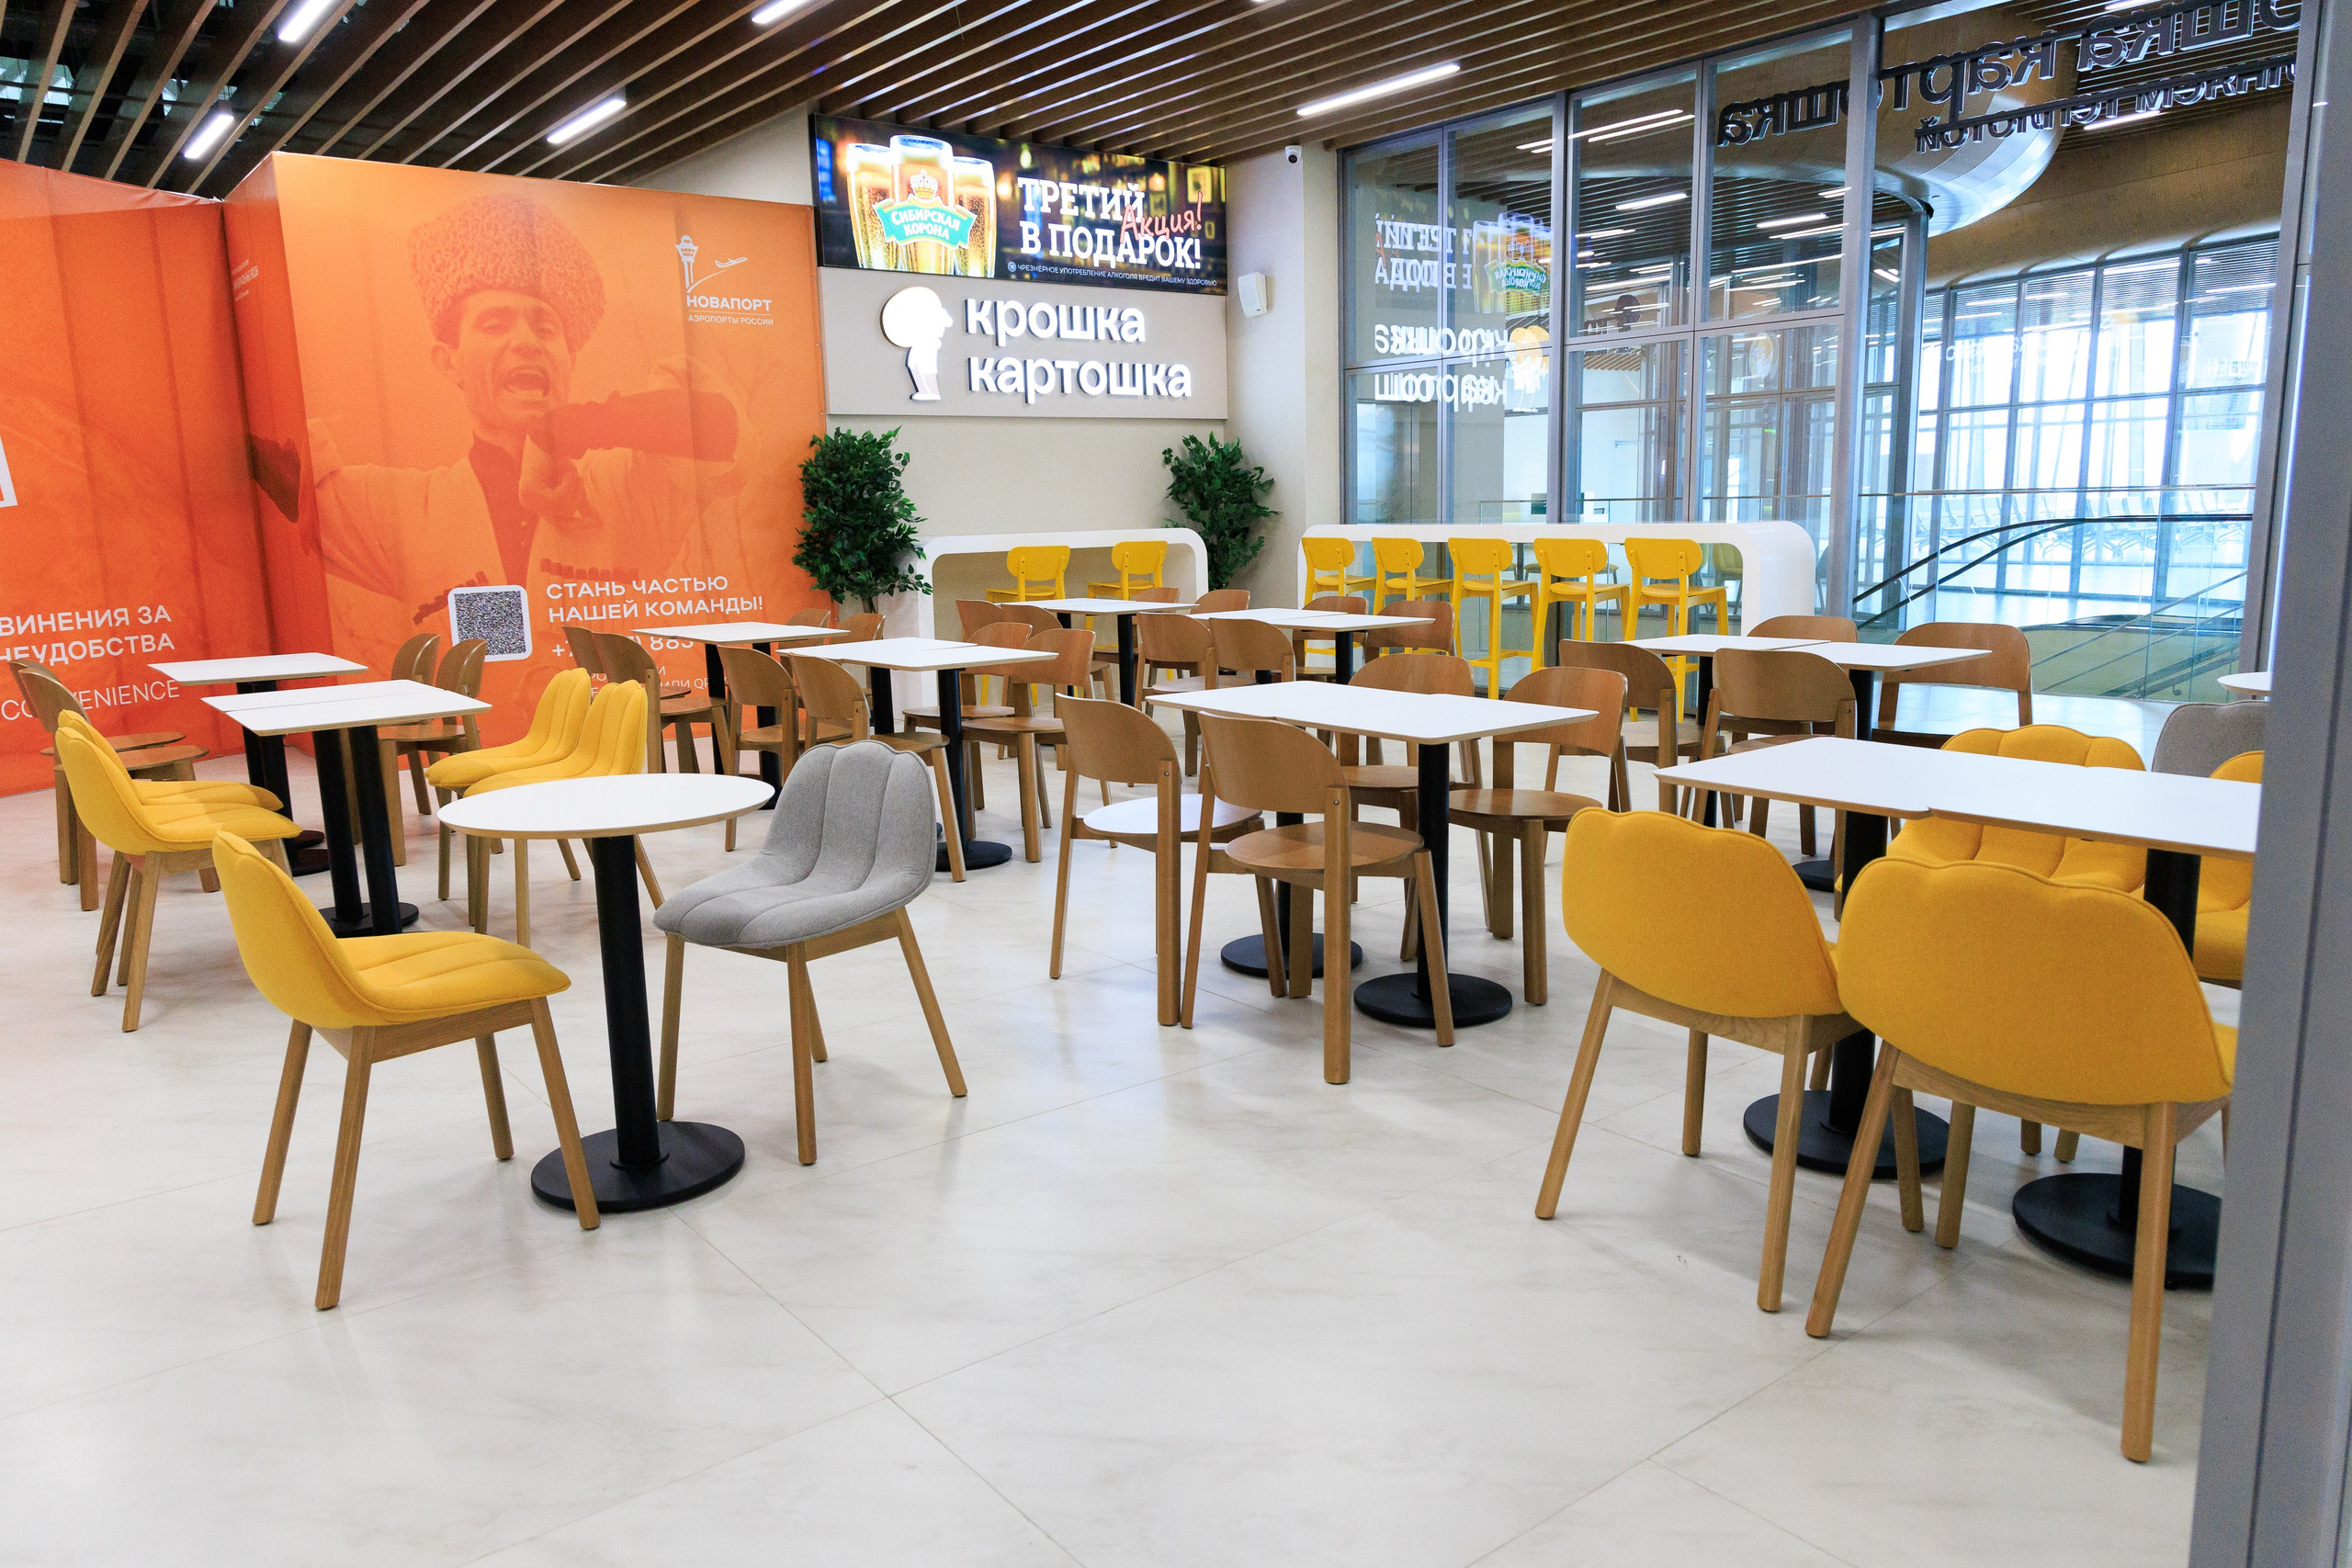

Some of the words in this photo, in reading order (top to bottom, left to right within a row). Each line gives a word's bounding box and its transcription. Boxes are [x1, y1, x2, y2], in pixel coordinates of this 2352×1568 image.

[1017, 176, 1146, 223] ТРЕТИЙ
[890, 209, 961, 231] СИБИРСКАЯ
[903, 222, 950, 240] КОРОНА
[1120, 190, 1204, 244] Акция!
[1020, 220, 1041, 254] В
[1048, 223, 1202, 269] ПОДАРОК!
[1017, 264, 1058, 274] ЧРЕЗМЕРНОЕ
[1059, 266, 1107, 278] УПОТРЕБЛЕНИЕ
[1107, 271, 1138, 281] АЛКОГОЛЯ
[1138, 274, 1160, 282] ВРЕДИТ
[1161, 275, 1185, 285] ВАШЕМУ
[1185, 277, 1217, 287] ЗДОРОВЬЮ
[686, 295, 773, 311] НОВАПОРТ
[688, 314, 739, 324] АЭРОПОРТЫ
[741, 317, 774, 325] РОССИИ
[965, 298, 1147, 347] крошка
[967, 355, 1193, 405] картошка
[546, 581, 627, 600] СТАНЬ
[631, 575, 729, 594] ЧАСТЬЮ
[0, 607, 130, 637] ВИНЕНИЯ
[138, 604, 172, 625] ЗА
[548, 599, 640, 624] НАШЕЙ
[645, 595, 764, 617] КОМАНДЫ!
[1, 680, 180, 720] CENIENCE
